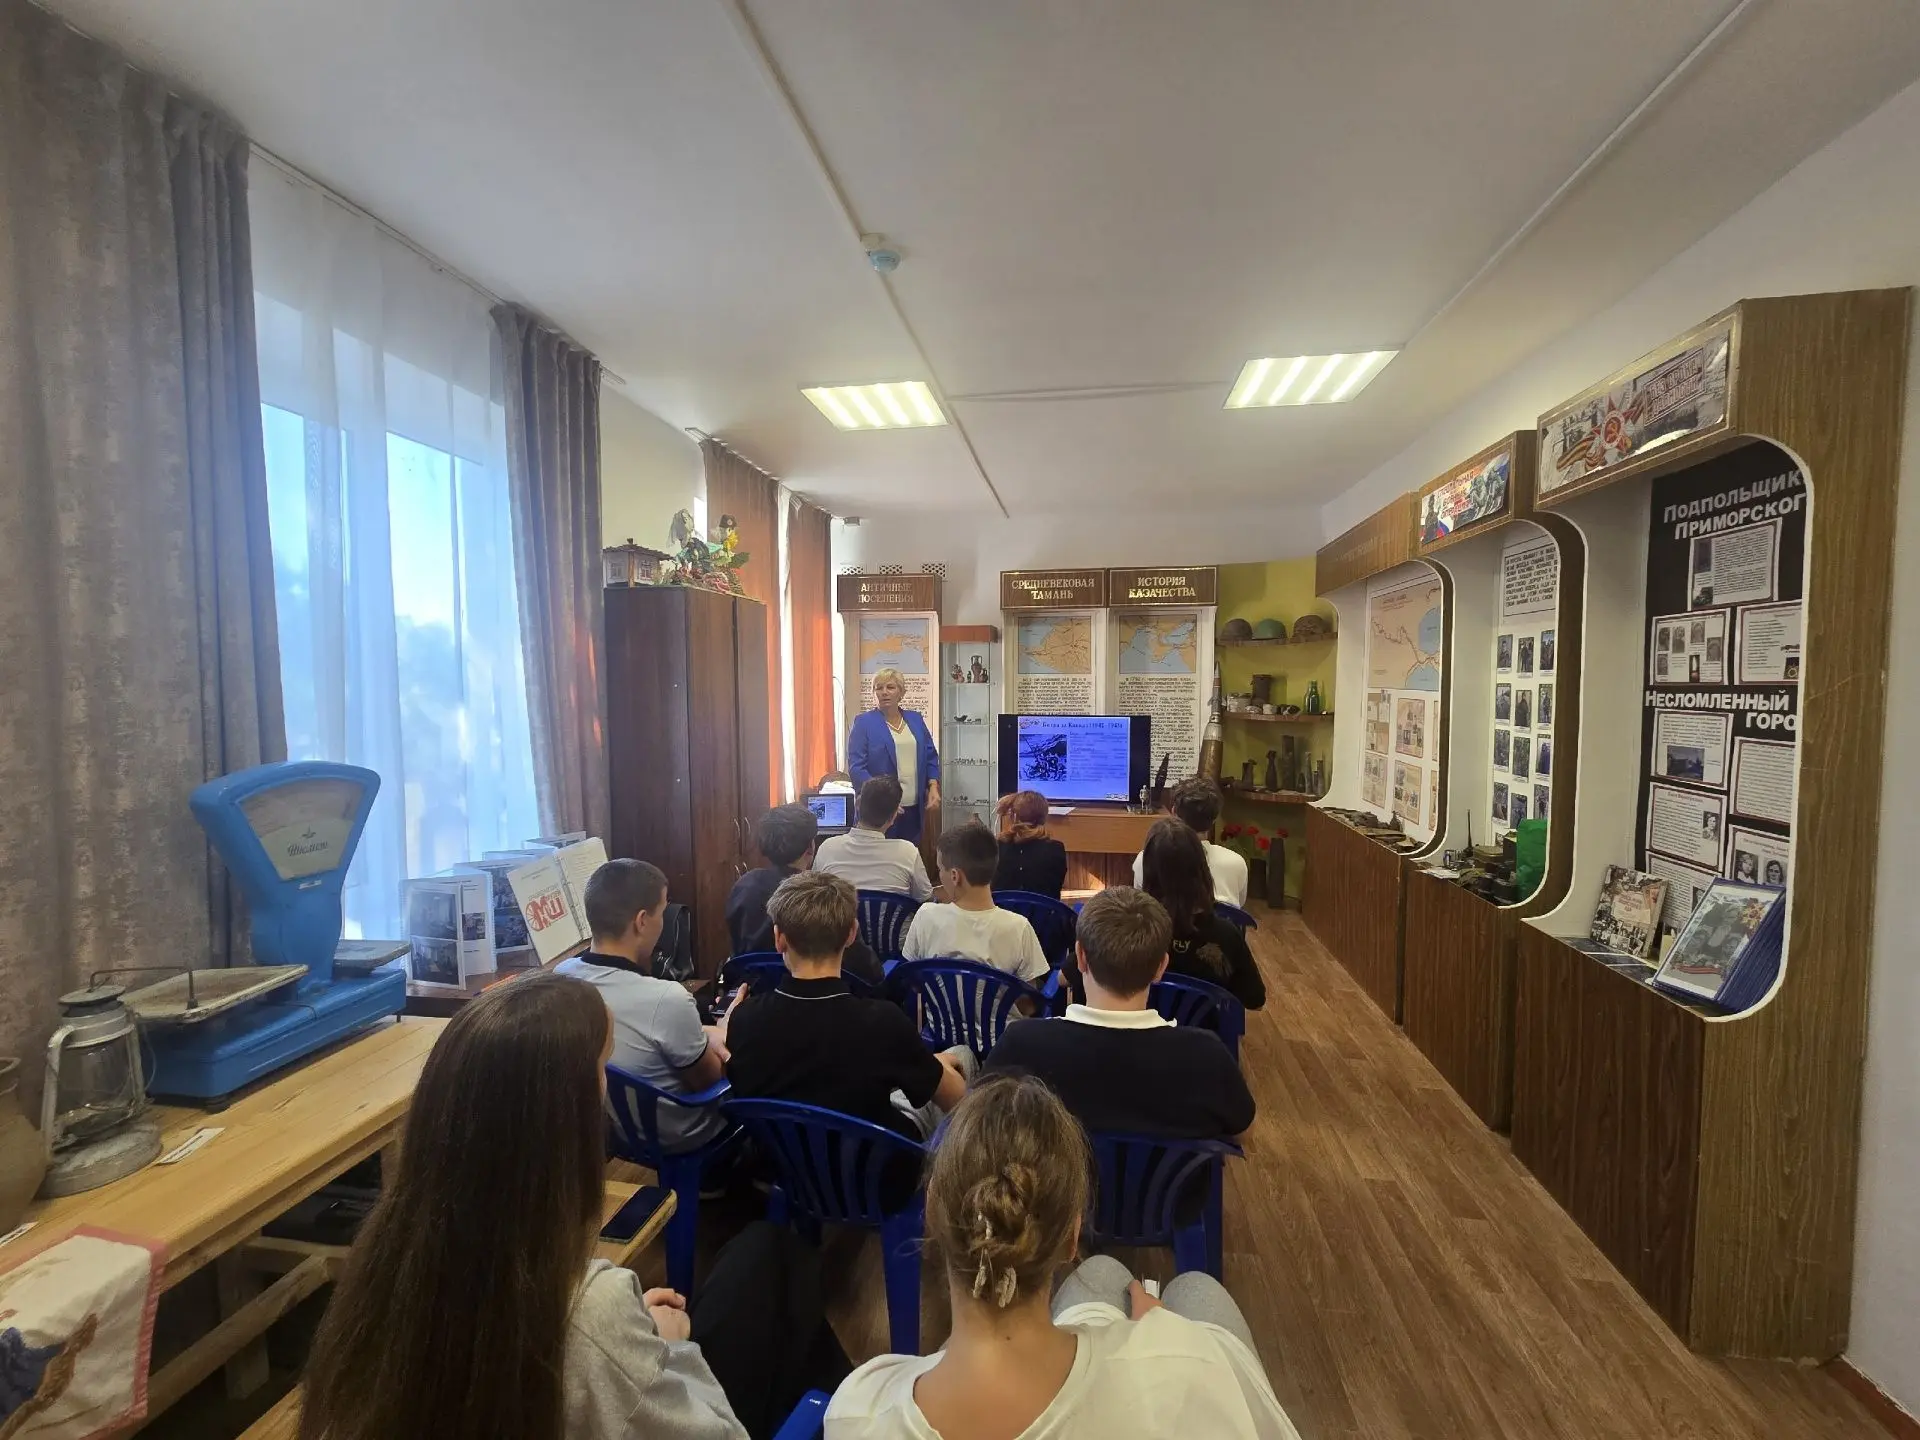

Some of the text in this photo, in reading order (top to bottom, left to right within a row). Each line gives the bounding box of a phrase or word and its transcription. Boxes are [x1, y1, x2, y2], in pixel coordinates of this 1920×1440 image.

[1663, 470, 1804, 523] ПОДПОЛЬЩИК
[1674, 493, 1807, 540] ПРИМОРСКОГ
[1011, 579, 1095, 590] СРЕДНЕВЕКОВАЯ
[1137, 576, 1186, 586] ИСТОРИЯ
[861, 583, 912, 592] АНТИЧНЫЕ
[1128, 587, 1196, 598] КАЗАЧЕСТВА
[858, 594, 914, 603] ПОСЕЛЕНИЯ
[1031, 590, 1073, 600] ТАМАНЬ
[1645, 690, 1789, 711] НЕСЛОМЛЕННЫЙ
[1745, 712, 1797, 731] ГОРО
[1173, 940, 1191, 949] FLY
